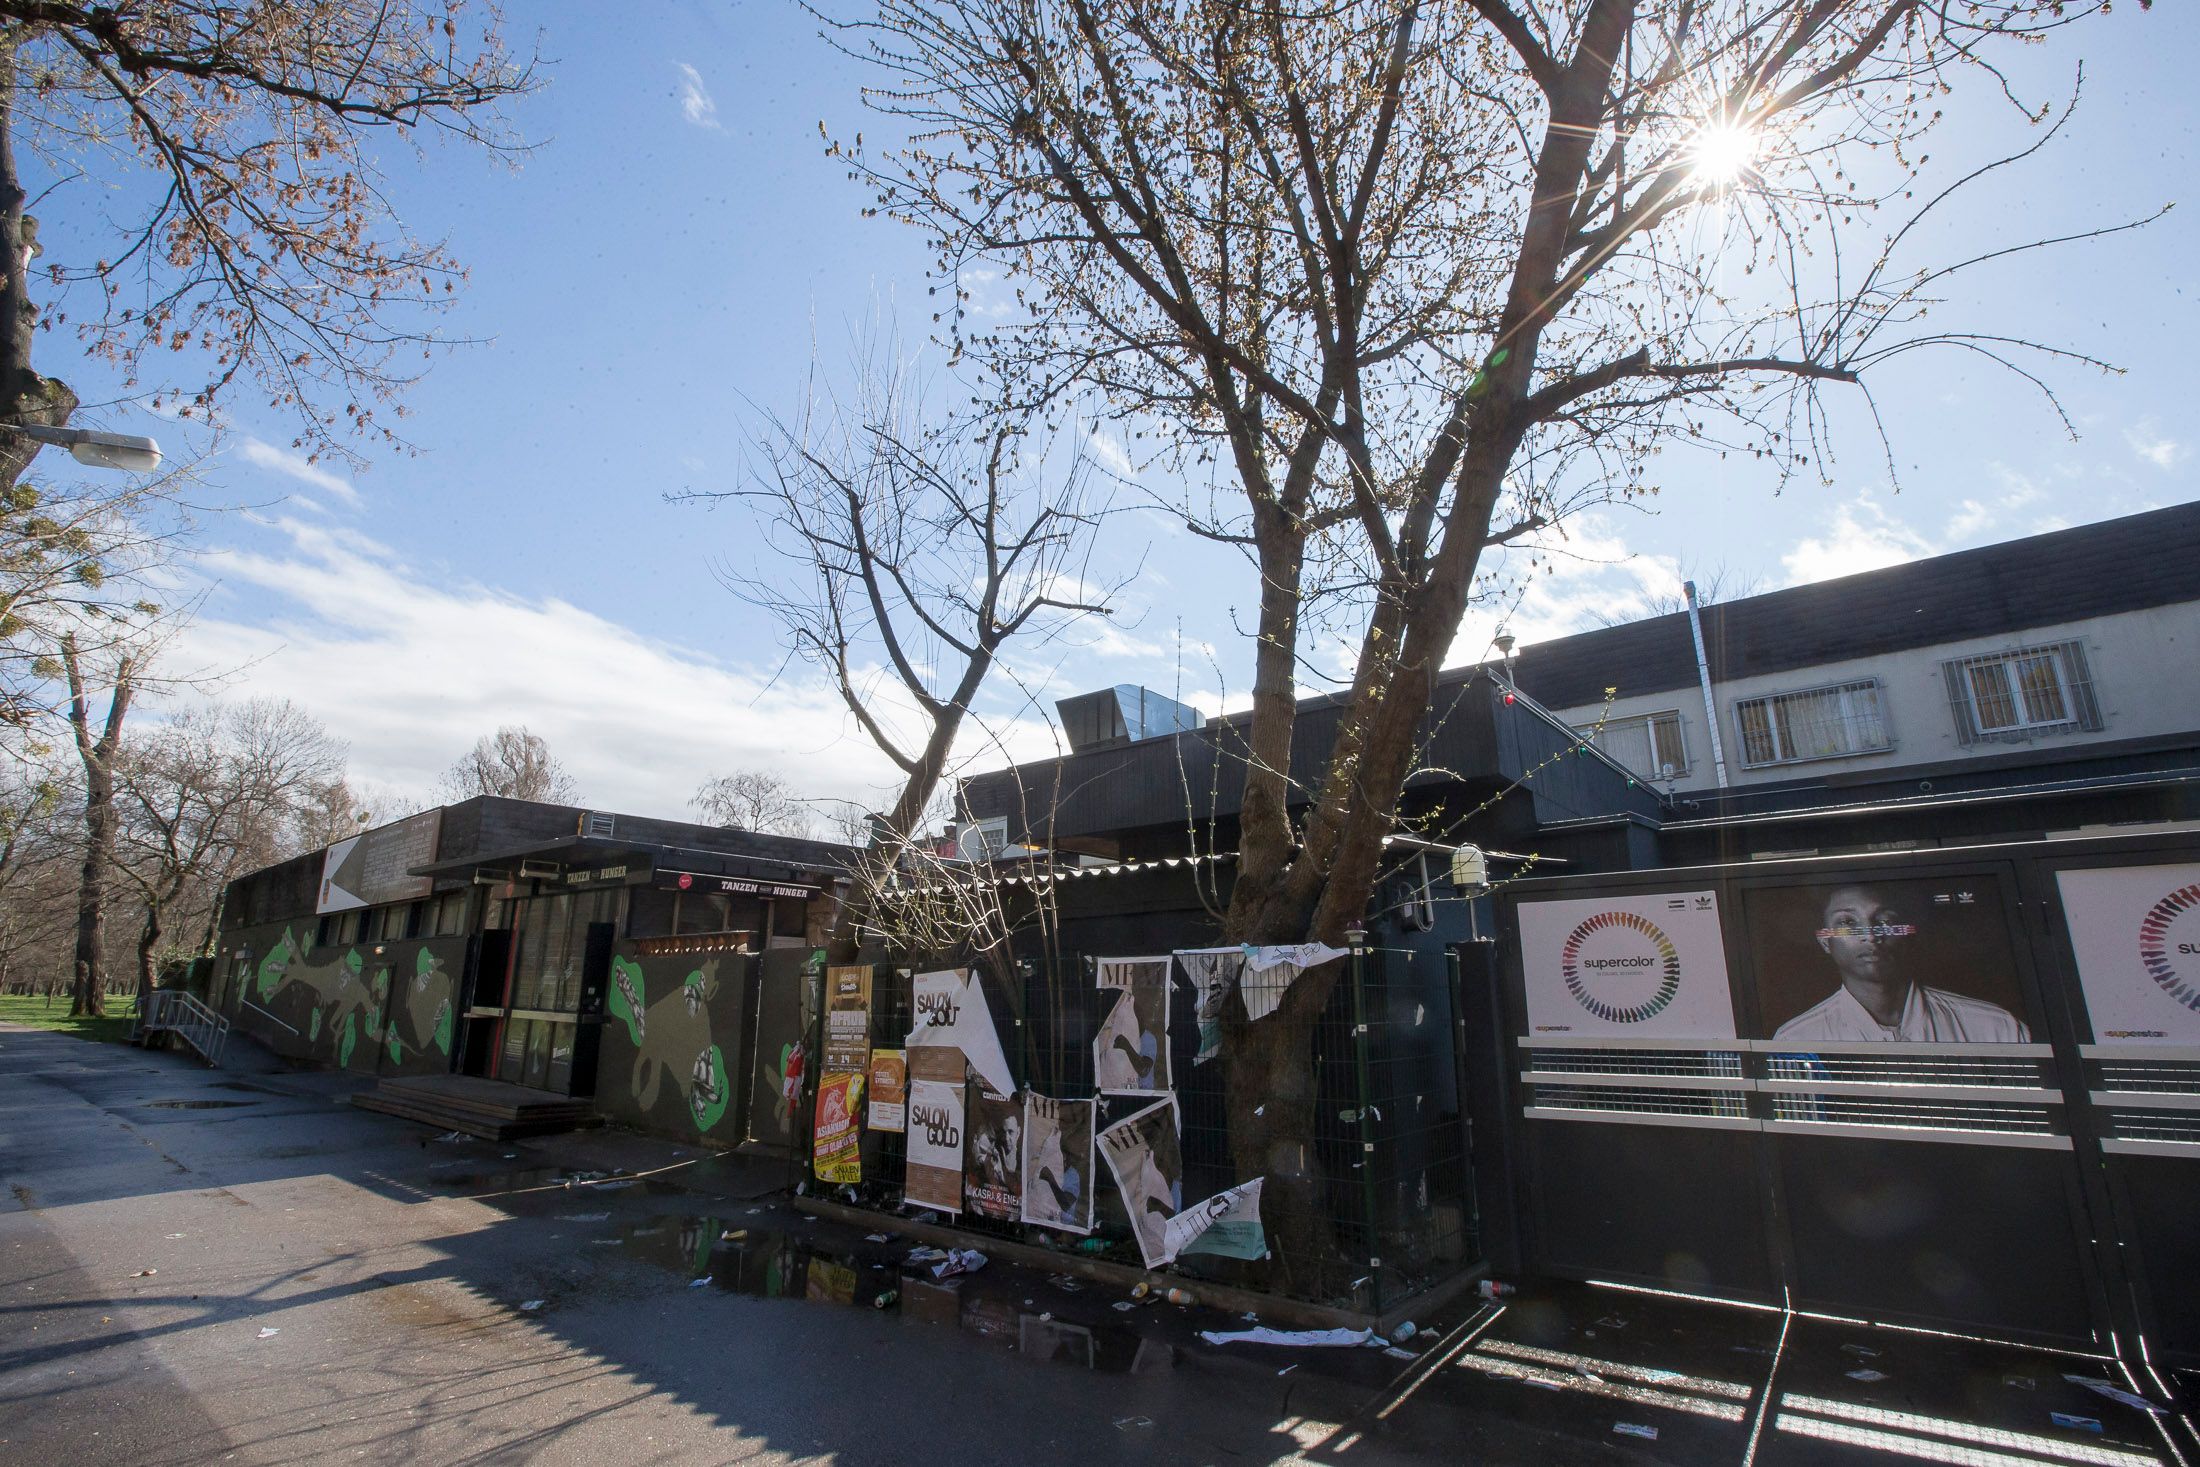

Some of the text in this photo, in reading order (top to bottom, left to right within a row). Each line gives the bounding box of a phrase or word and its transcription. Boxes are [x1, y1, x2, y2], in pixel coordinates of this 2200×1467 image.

[567, 870, 590, 884] TANZEN
[600, 865, 627, 880] HUNGER
[721, 881, 758, 893] TANZEN
[773, 886, 808, 898] HUNGER
[1584, 956, 1655, 970] supercolor
[912, 1104, 950, 1130] SALON
[927, 1126, 960, 1148] GOLD
[972, 1187, 995, 1200] KASRA
[996, 1192, 1002, 1203] &
